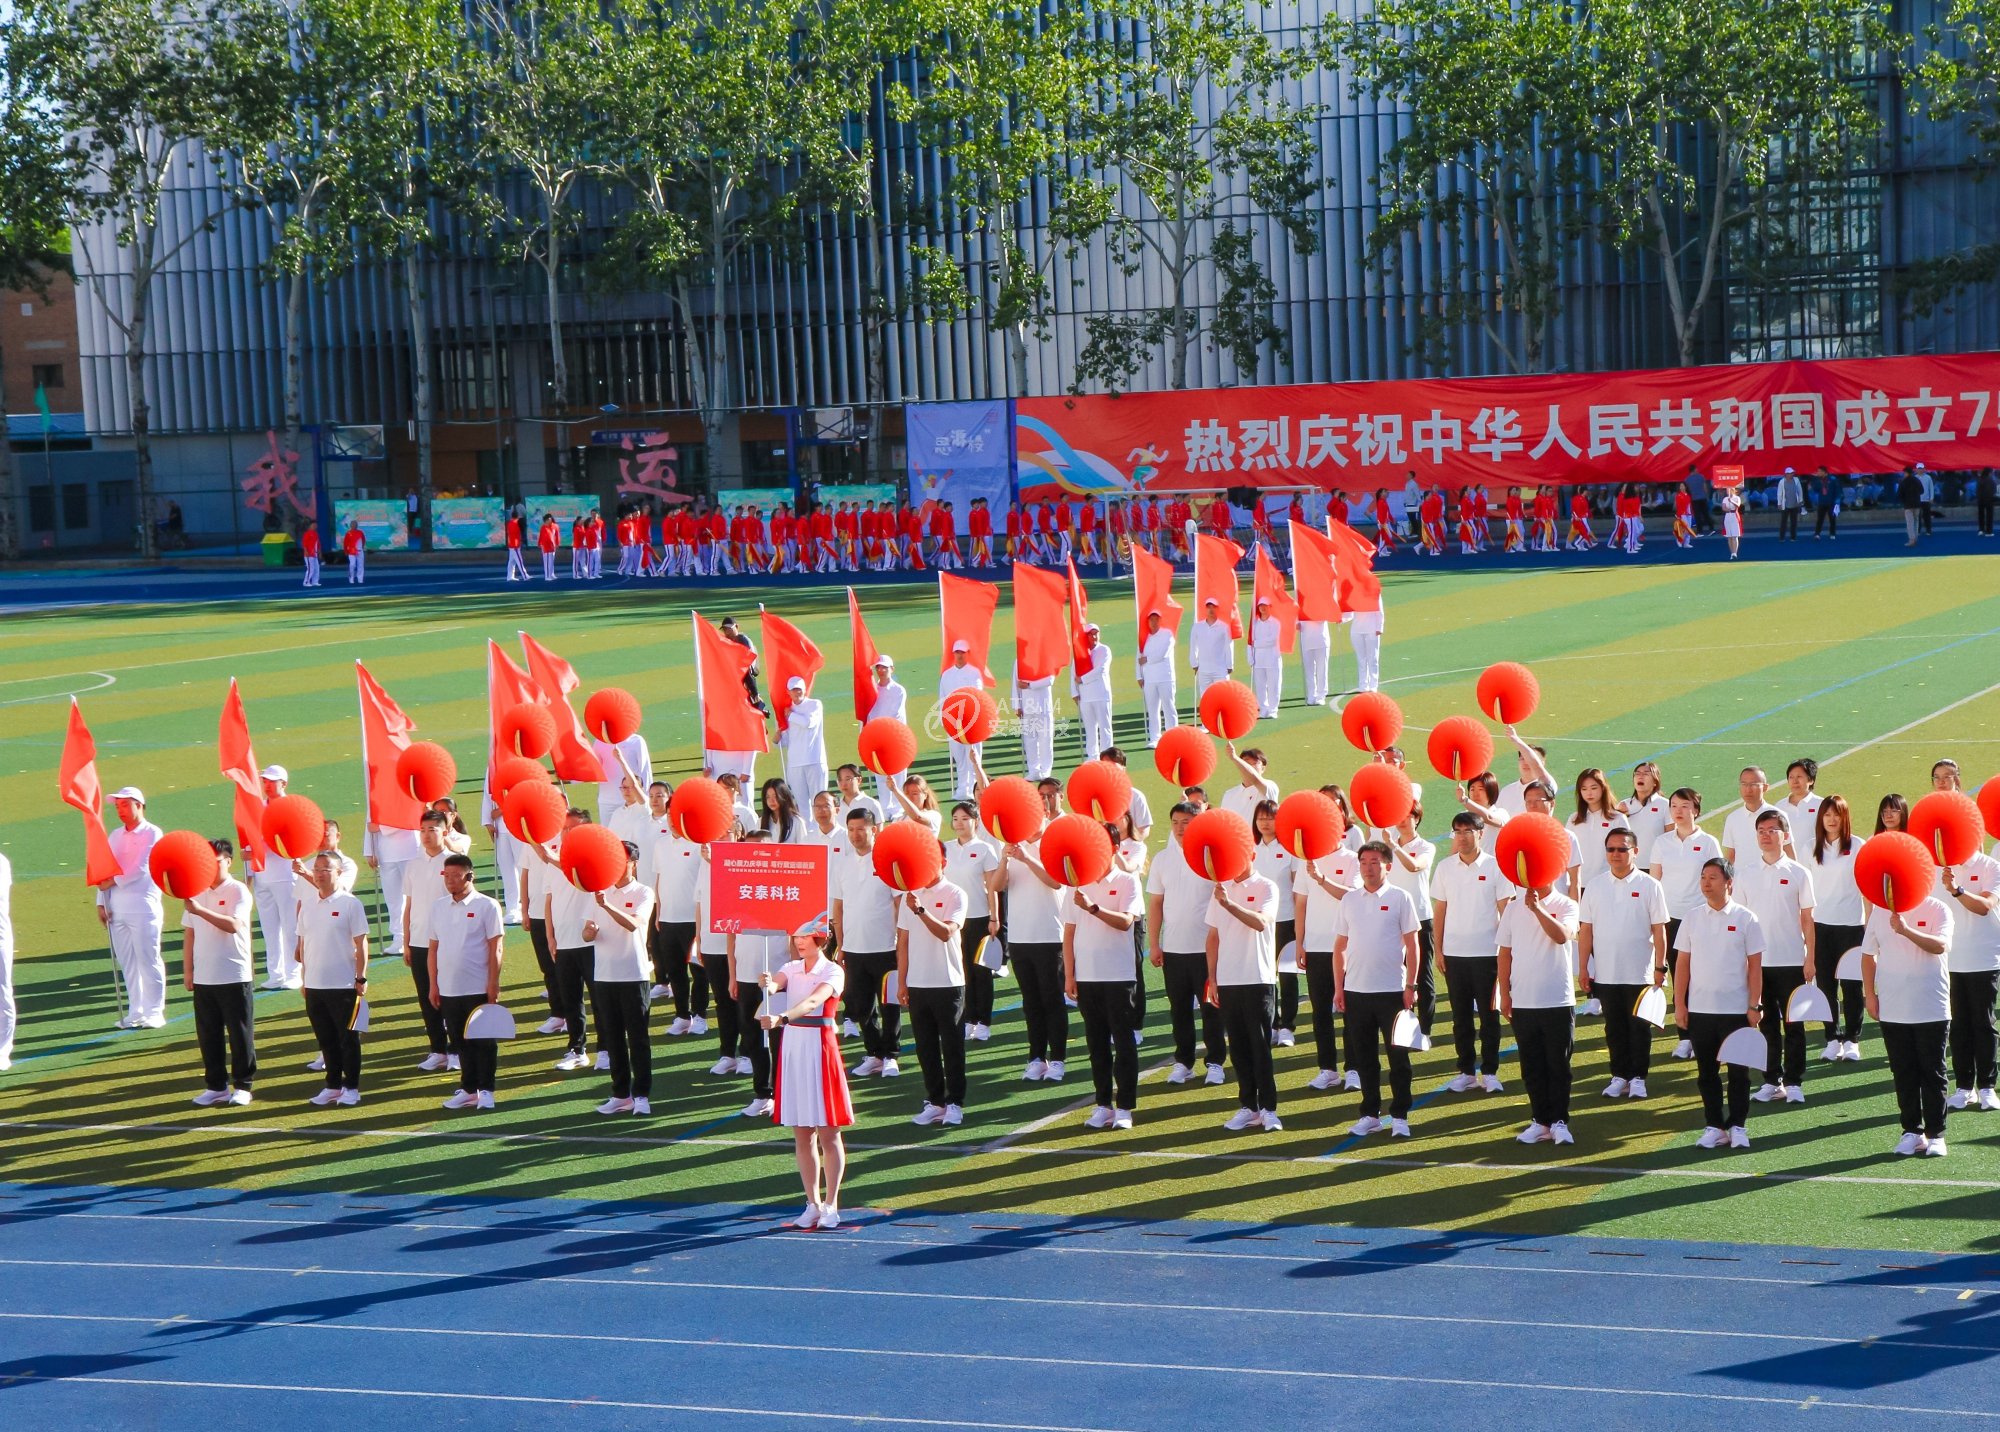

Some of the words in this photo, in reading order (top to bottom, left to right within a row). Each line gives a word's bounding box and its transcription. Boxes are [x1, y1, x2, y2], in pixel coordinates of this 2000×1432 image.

[1184, 387, 2000, 474] 热烈庆祝中华人民共和国成立7
[242, 430, 317, 519] 我
[616, 432, 694, 503] 运
[739, 884, 801, 902] 安泰科技
